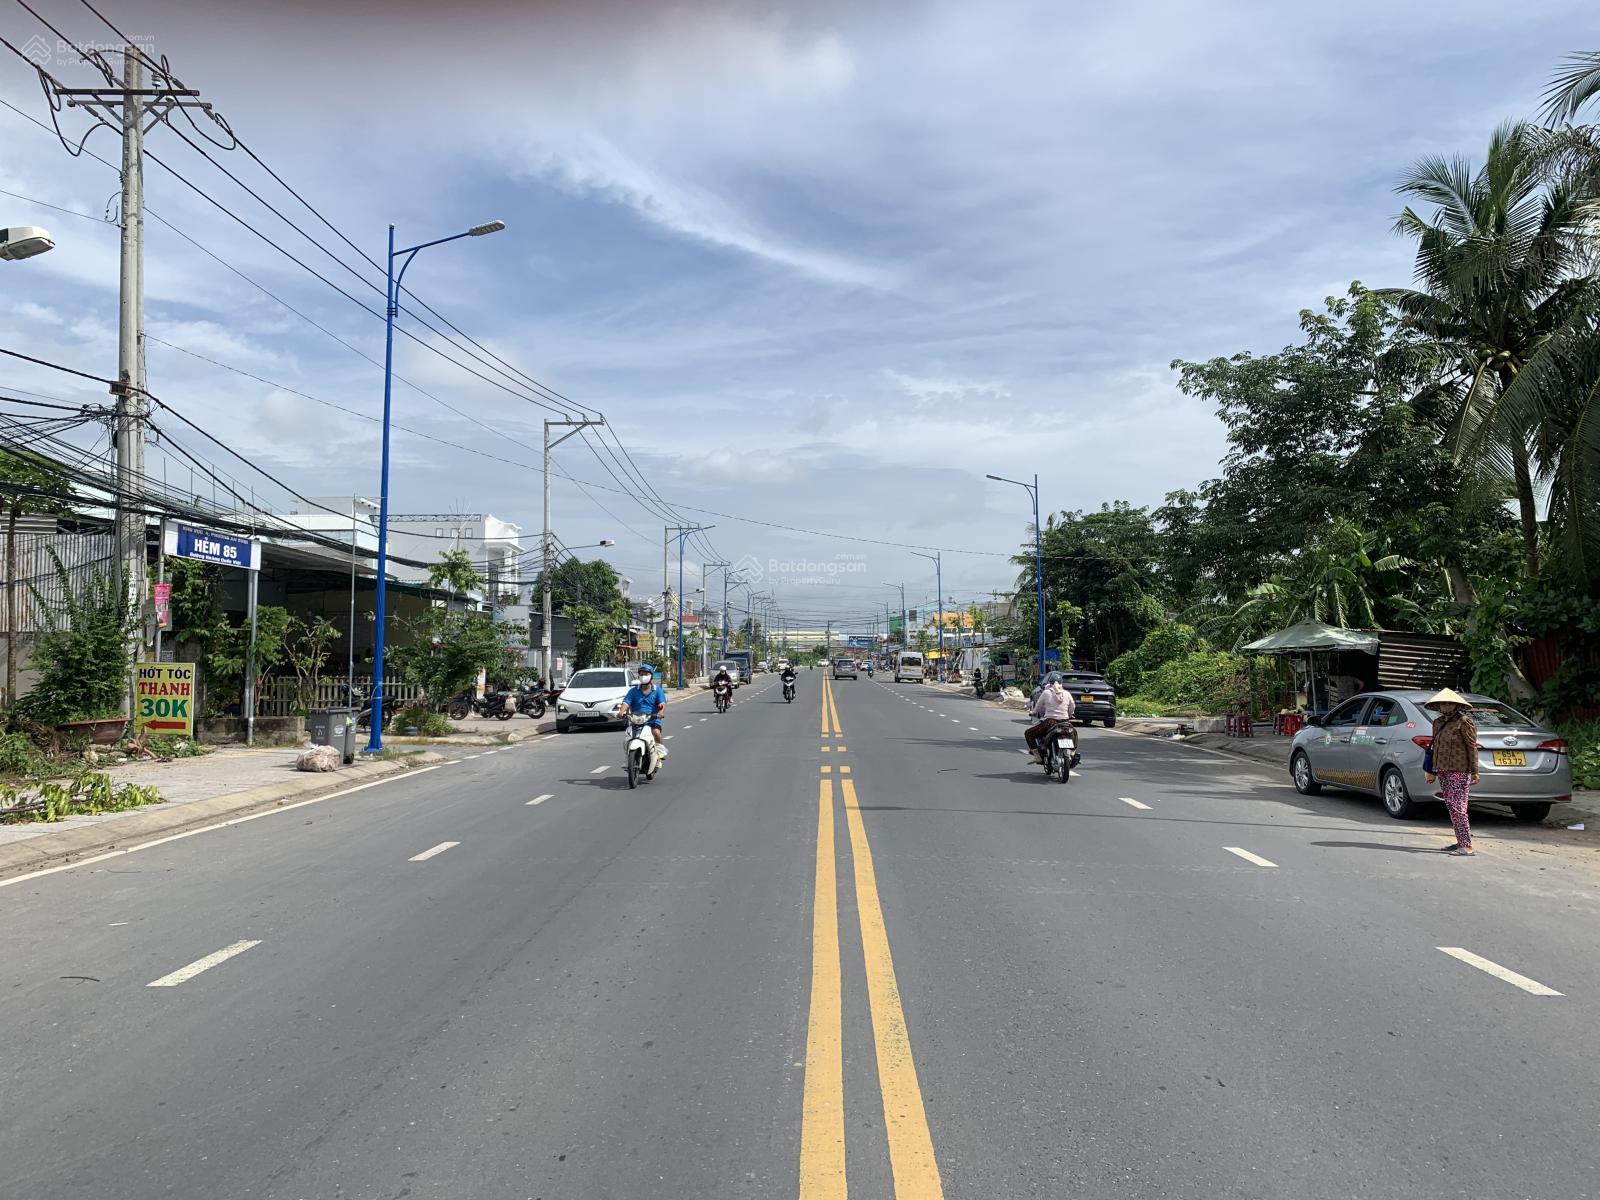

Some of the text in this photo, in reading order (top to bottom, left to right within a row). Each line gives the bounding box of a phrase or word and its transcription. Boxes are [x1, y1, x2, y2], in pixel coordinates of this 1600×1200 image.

[194, 536, 237, 559] HẺM 85
[139, 665, 191, 679] HỚT TÓC
[138, 682, 190, 695] THANH
[140, 698, 189, 718] 30K
